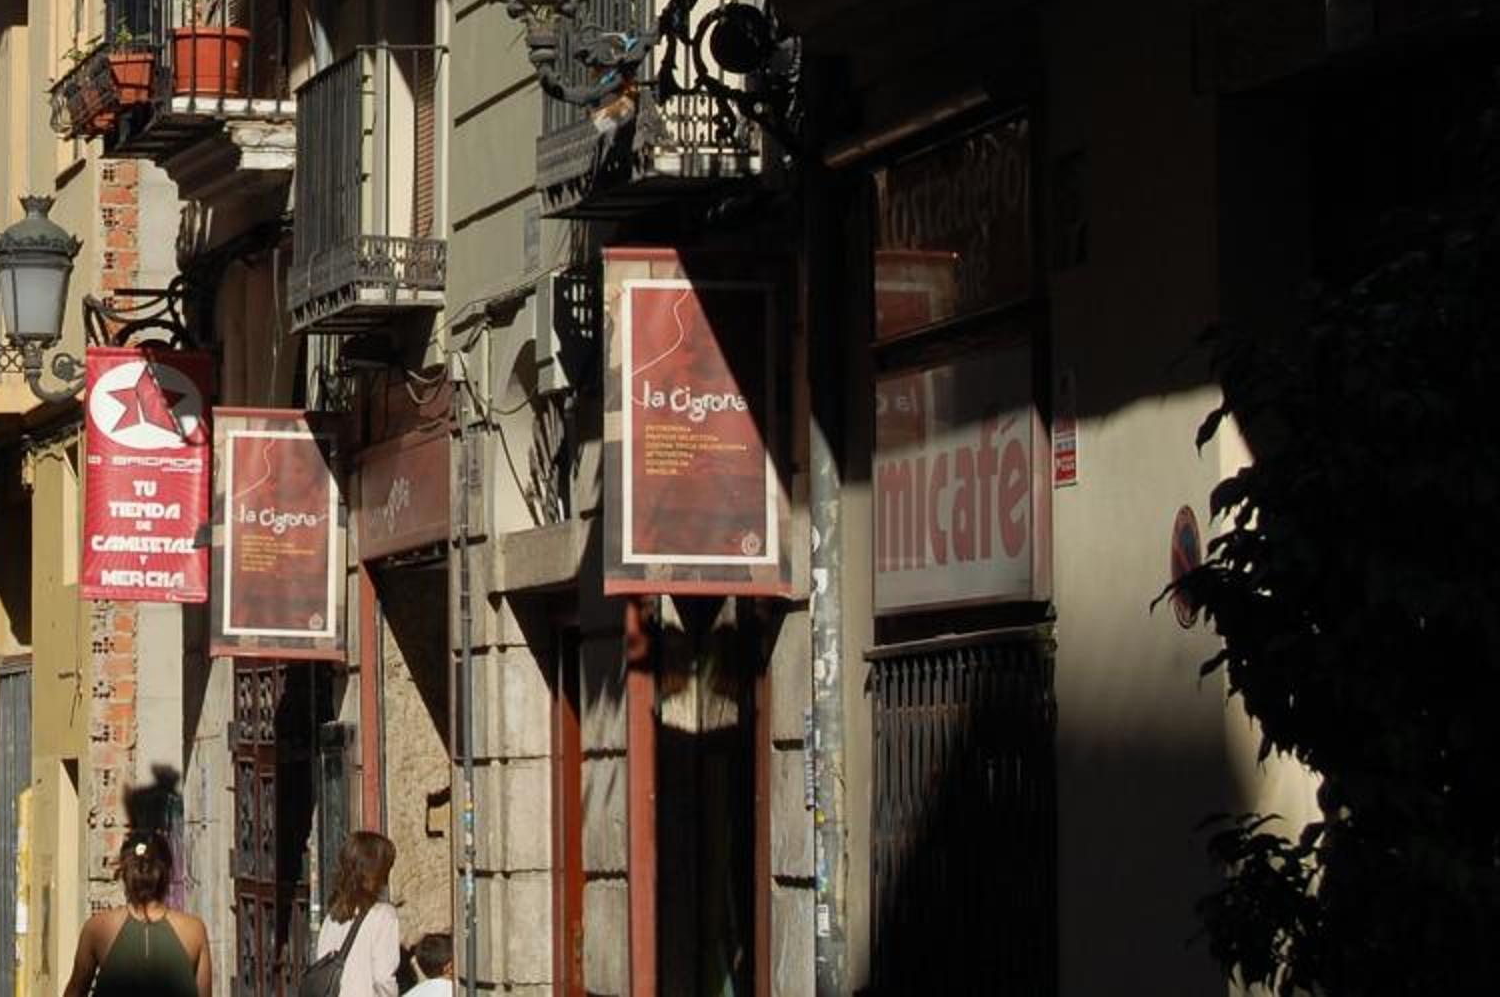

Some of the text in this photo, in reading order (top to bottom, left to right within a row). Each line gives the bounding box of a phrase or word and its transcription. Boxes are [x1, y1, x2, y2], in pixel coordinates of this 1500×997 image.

[643, 380, 665, 410] la
[132, 479, 157, 497] TU
[107, 500, 181, 519] TIENDA
[134, 520, 153, 532] DE
[91, 534, 197, 554] CAMISETAS
